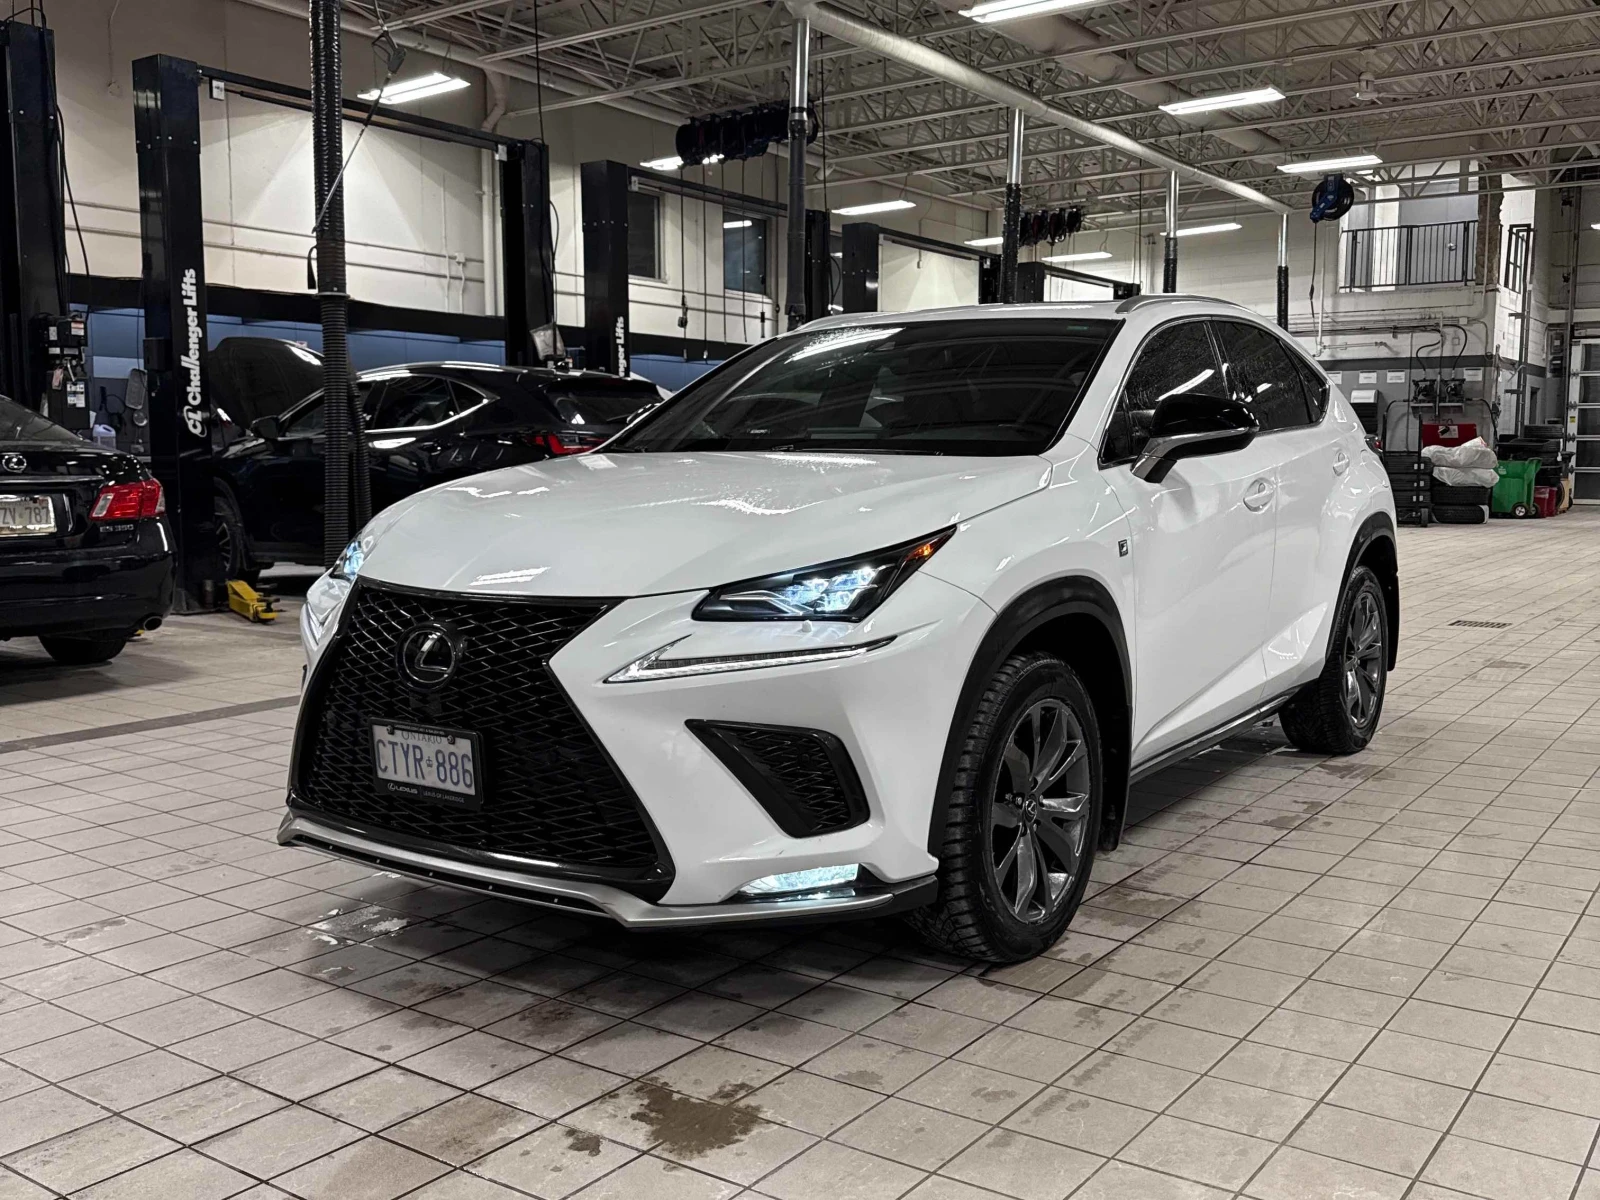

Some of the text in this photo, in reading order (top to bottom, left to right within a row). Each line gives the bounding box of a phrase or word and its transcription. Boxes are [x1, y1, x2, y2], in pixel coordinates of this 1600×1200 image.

[181, 268, 198, 306] Lifts
[615, 316, 625, 344] Lifts
[181, 307, 203, 406] Challenger
[25, 506, 50, 525] 787
[401, 730, 443, 744] ONTARIO
[376, 739, 473, 788] CTYR 886
[395, 785, 418, 794] LEXUS
